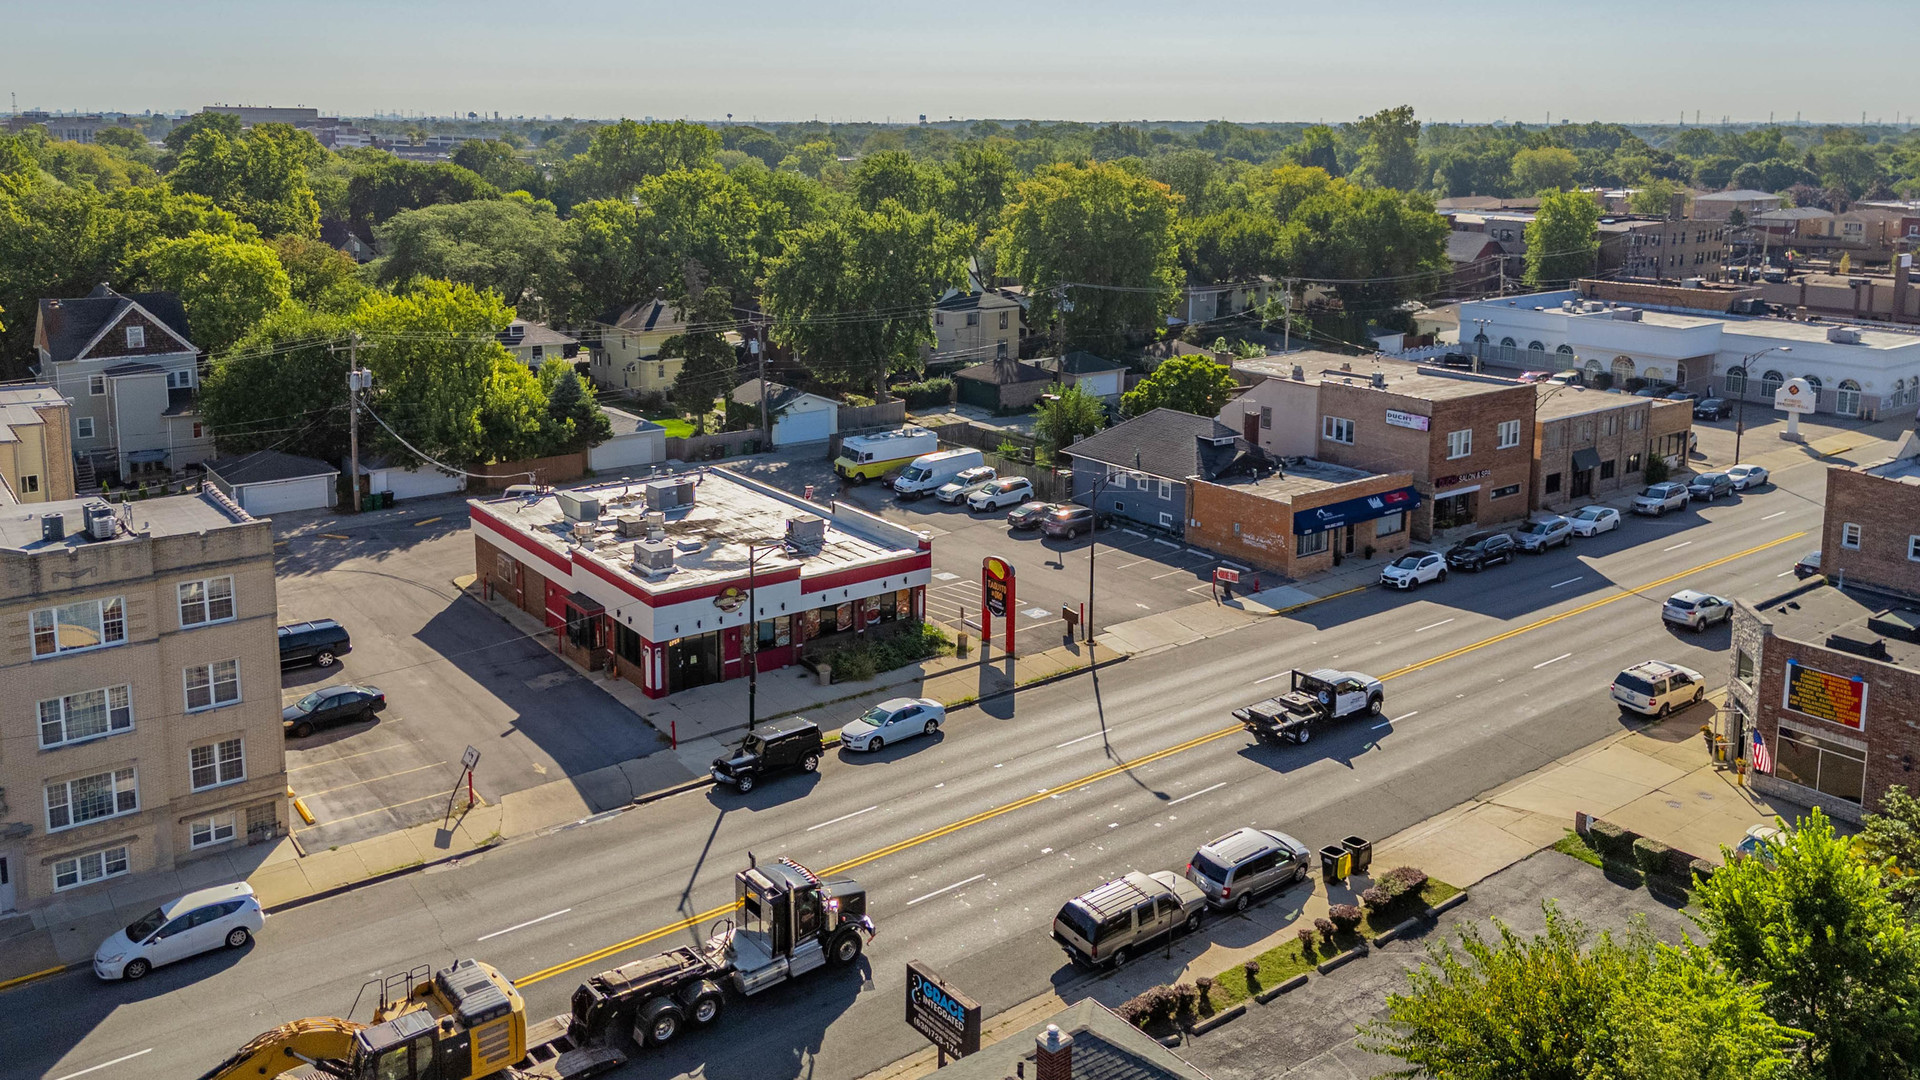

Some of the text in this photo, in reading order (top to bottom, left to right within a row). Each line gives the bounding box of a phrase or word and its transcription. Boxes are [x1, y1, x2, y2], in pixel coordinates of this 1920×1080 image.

[1458, 473, 1476, 483] SALON
[1481, 469, 1491, 479] SPA
[669, 638, 680, 647] OPEN
[1791, 680, 1822, 692] BATTERIES
[1834, 692, 1859, 703] CHANGE
[1795, 686, 1854, 706] CHECK ENGINE LIGHT
[1828, 685, 1852, 696] BRAKES
[1798, 692, 1851, 710] WHEEL ALIGNMENT
[1799, 701, 1836, 716] CONDITIONING
[1836, 712, 1859, 723] SERVICE
[1802, 707, 1845, 724] TOWING SERVICE
[1833, 706, 1861, 718] MUFFLERS
[923, 981, 965, 1023] GRACE
[923, 994, 965, 1032] INTEGRATED
